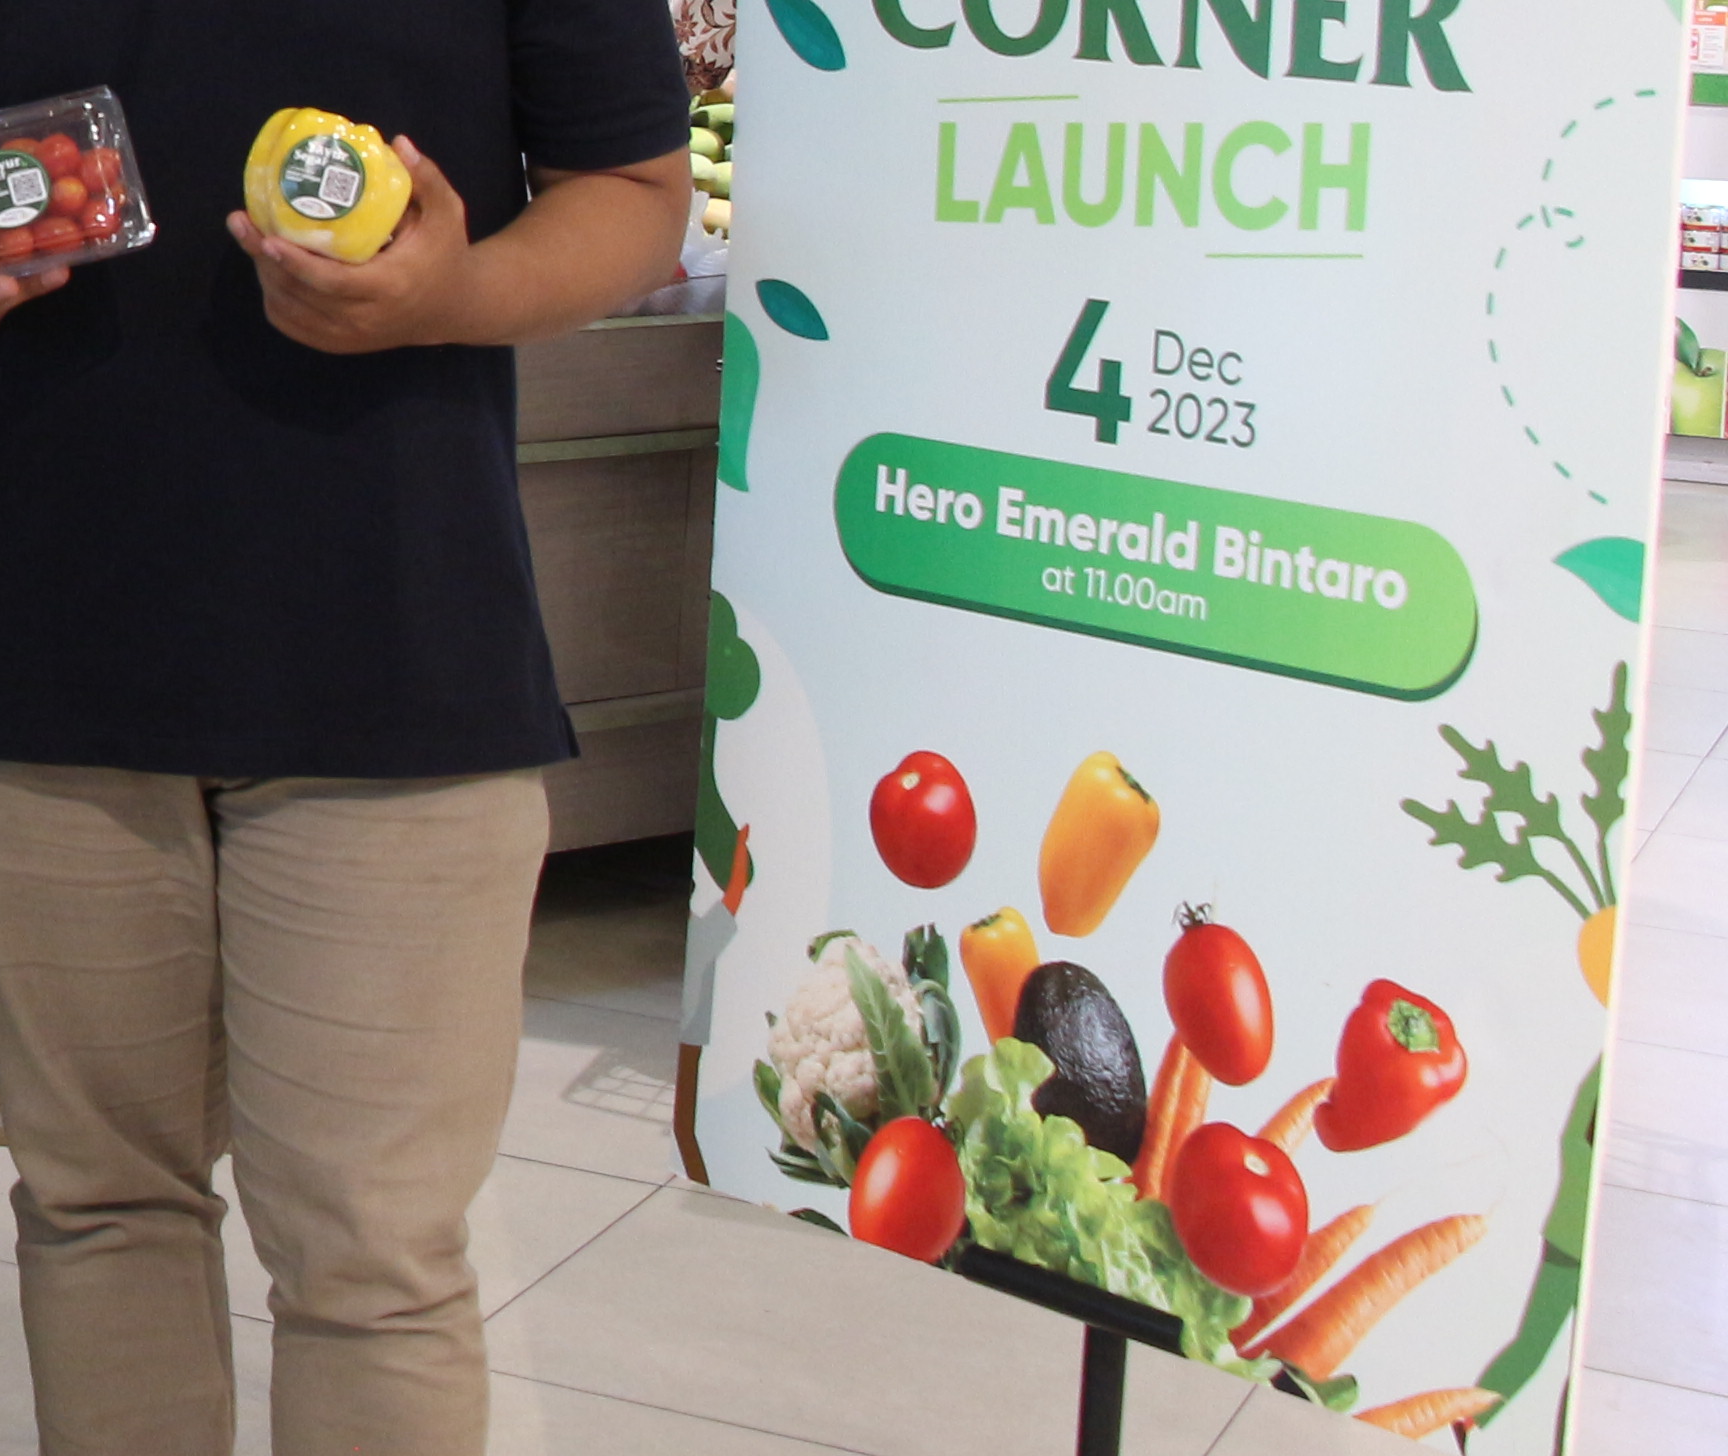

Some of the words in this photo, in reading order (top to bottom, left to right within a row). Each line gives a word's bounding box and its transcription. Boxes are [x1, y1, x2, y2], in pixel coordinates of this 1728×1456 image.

[934, 120, 1372, 233] LAUNCH
[1043, 297, 1133, 445] 4
[1151, 328, 1244, 386] Dec
[1147, 388, 1258, 450] 2023
[874, 463, 981, 529] Hero
[995, 486, 1199, 572] Emerald
[1211, 527, 1409, 611] Bintaro
[1041, 566, 1074, 596] at
[1082, 567, 1208, 623] 11.00am
